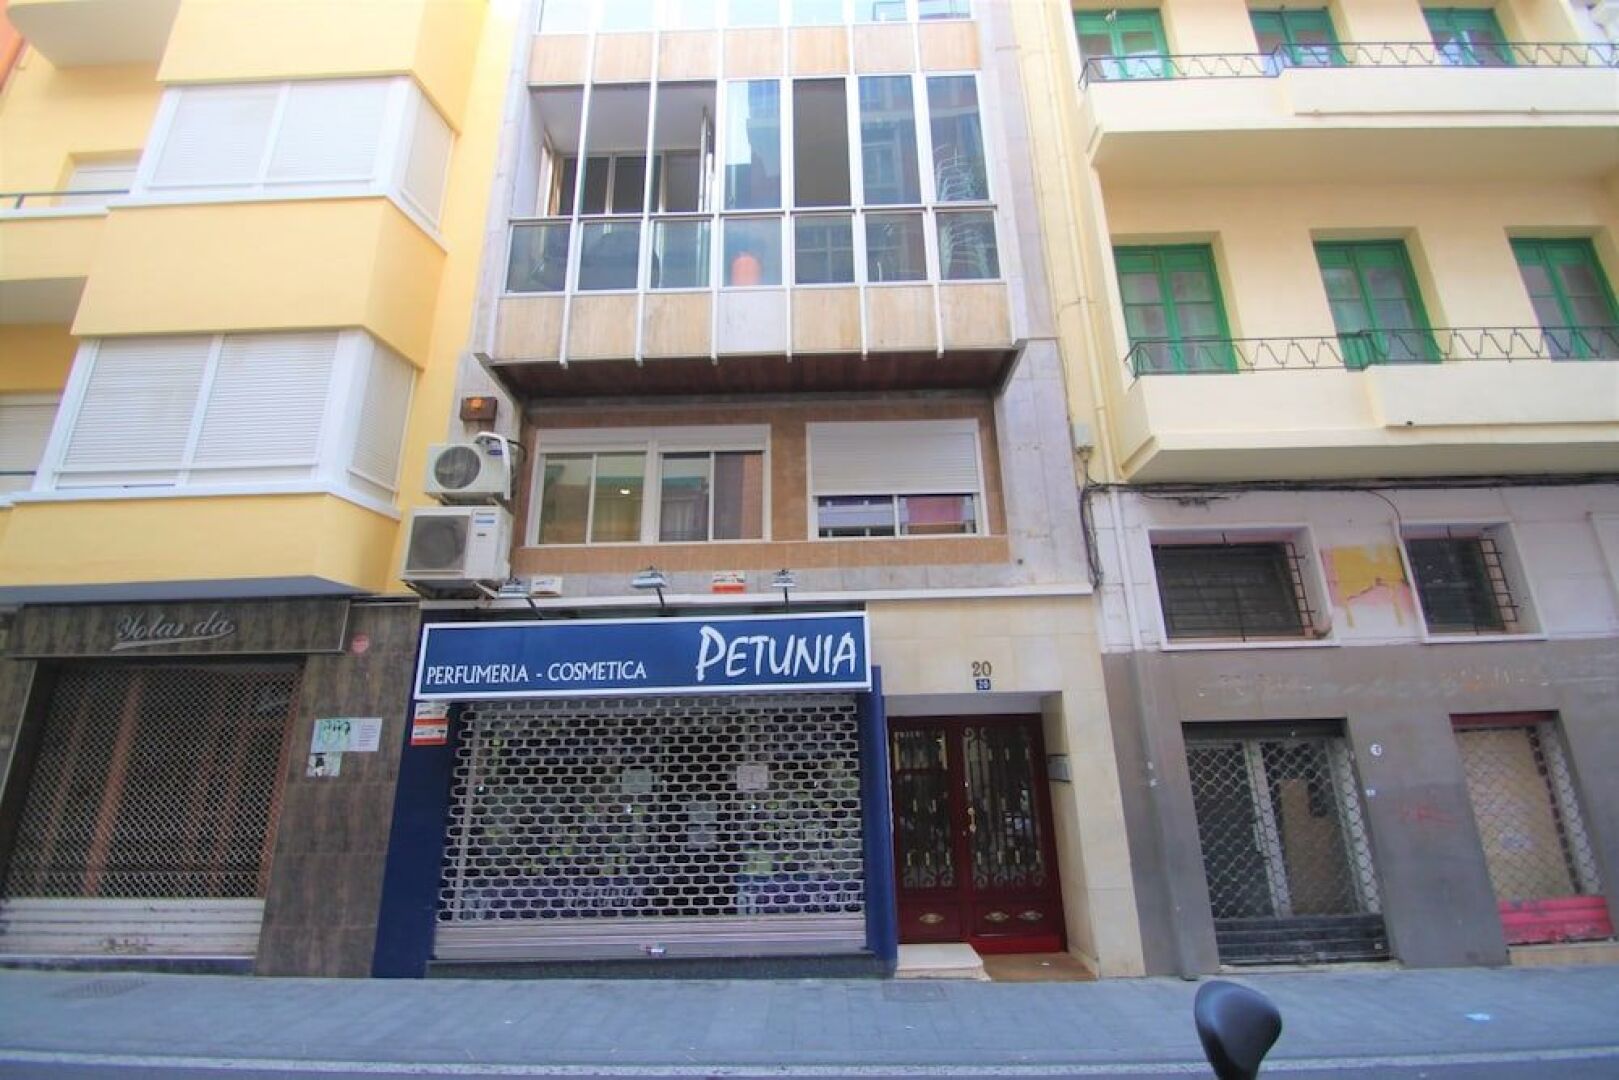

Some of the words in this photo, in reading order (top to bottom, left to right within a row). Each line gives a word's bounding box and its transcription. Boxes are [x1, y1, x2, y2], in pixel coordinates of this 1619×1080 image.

[695, 624, 857, 682] PETUNIA
[425, 664, 529, 685] PERFUMERIA
[547, 660, 647, 681] COSMETICA
[971, 660, 992, 678] 20
